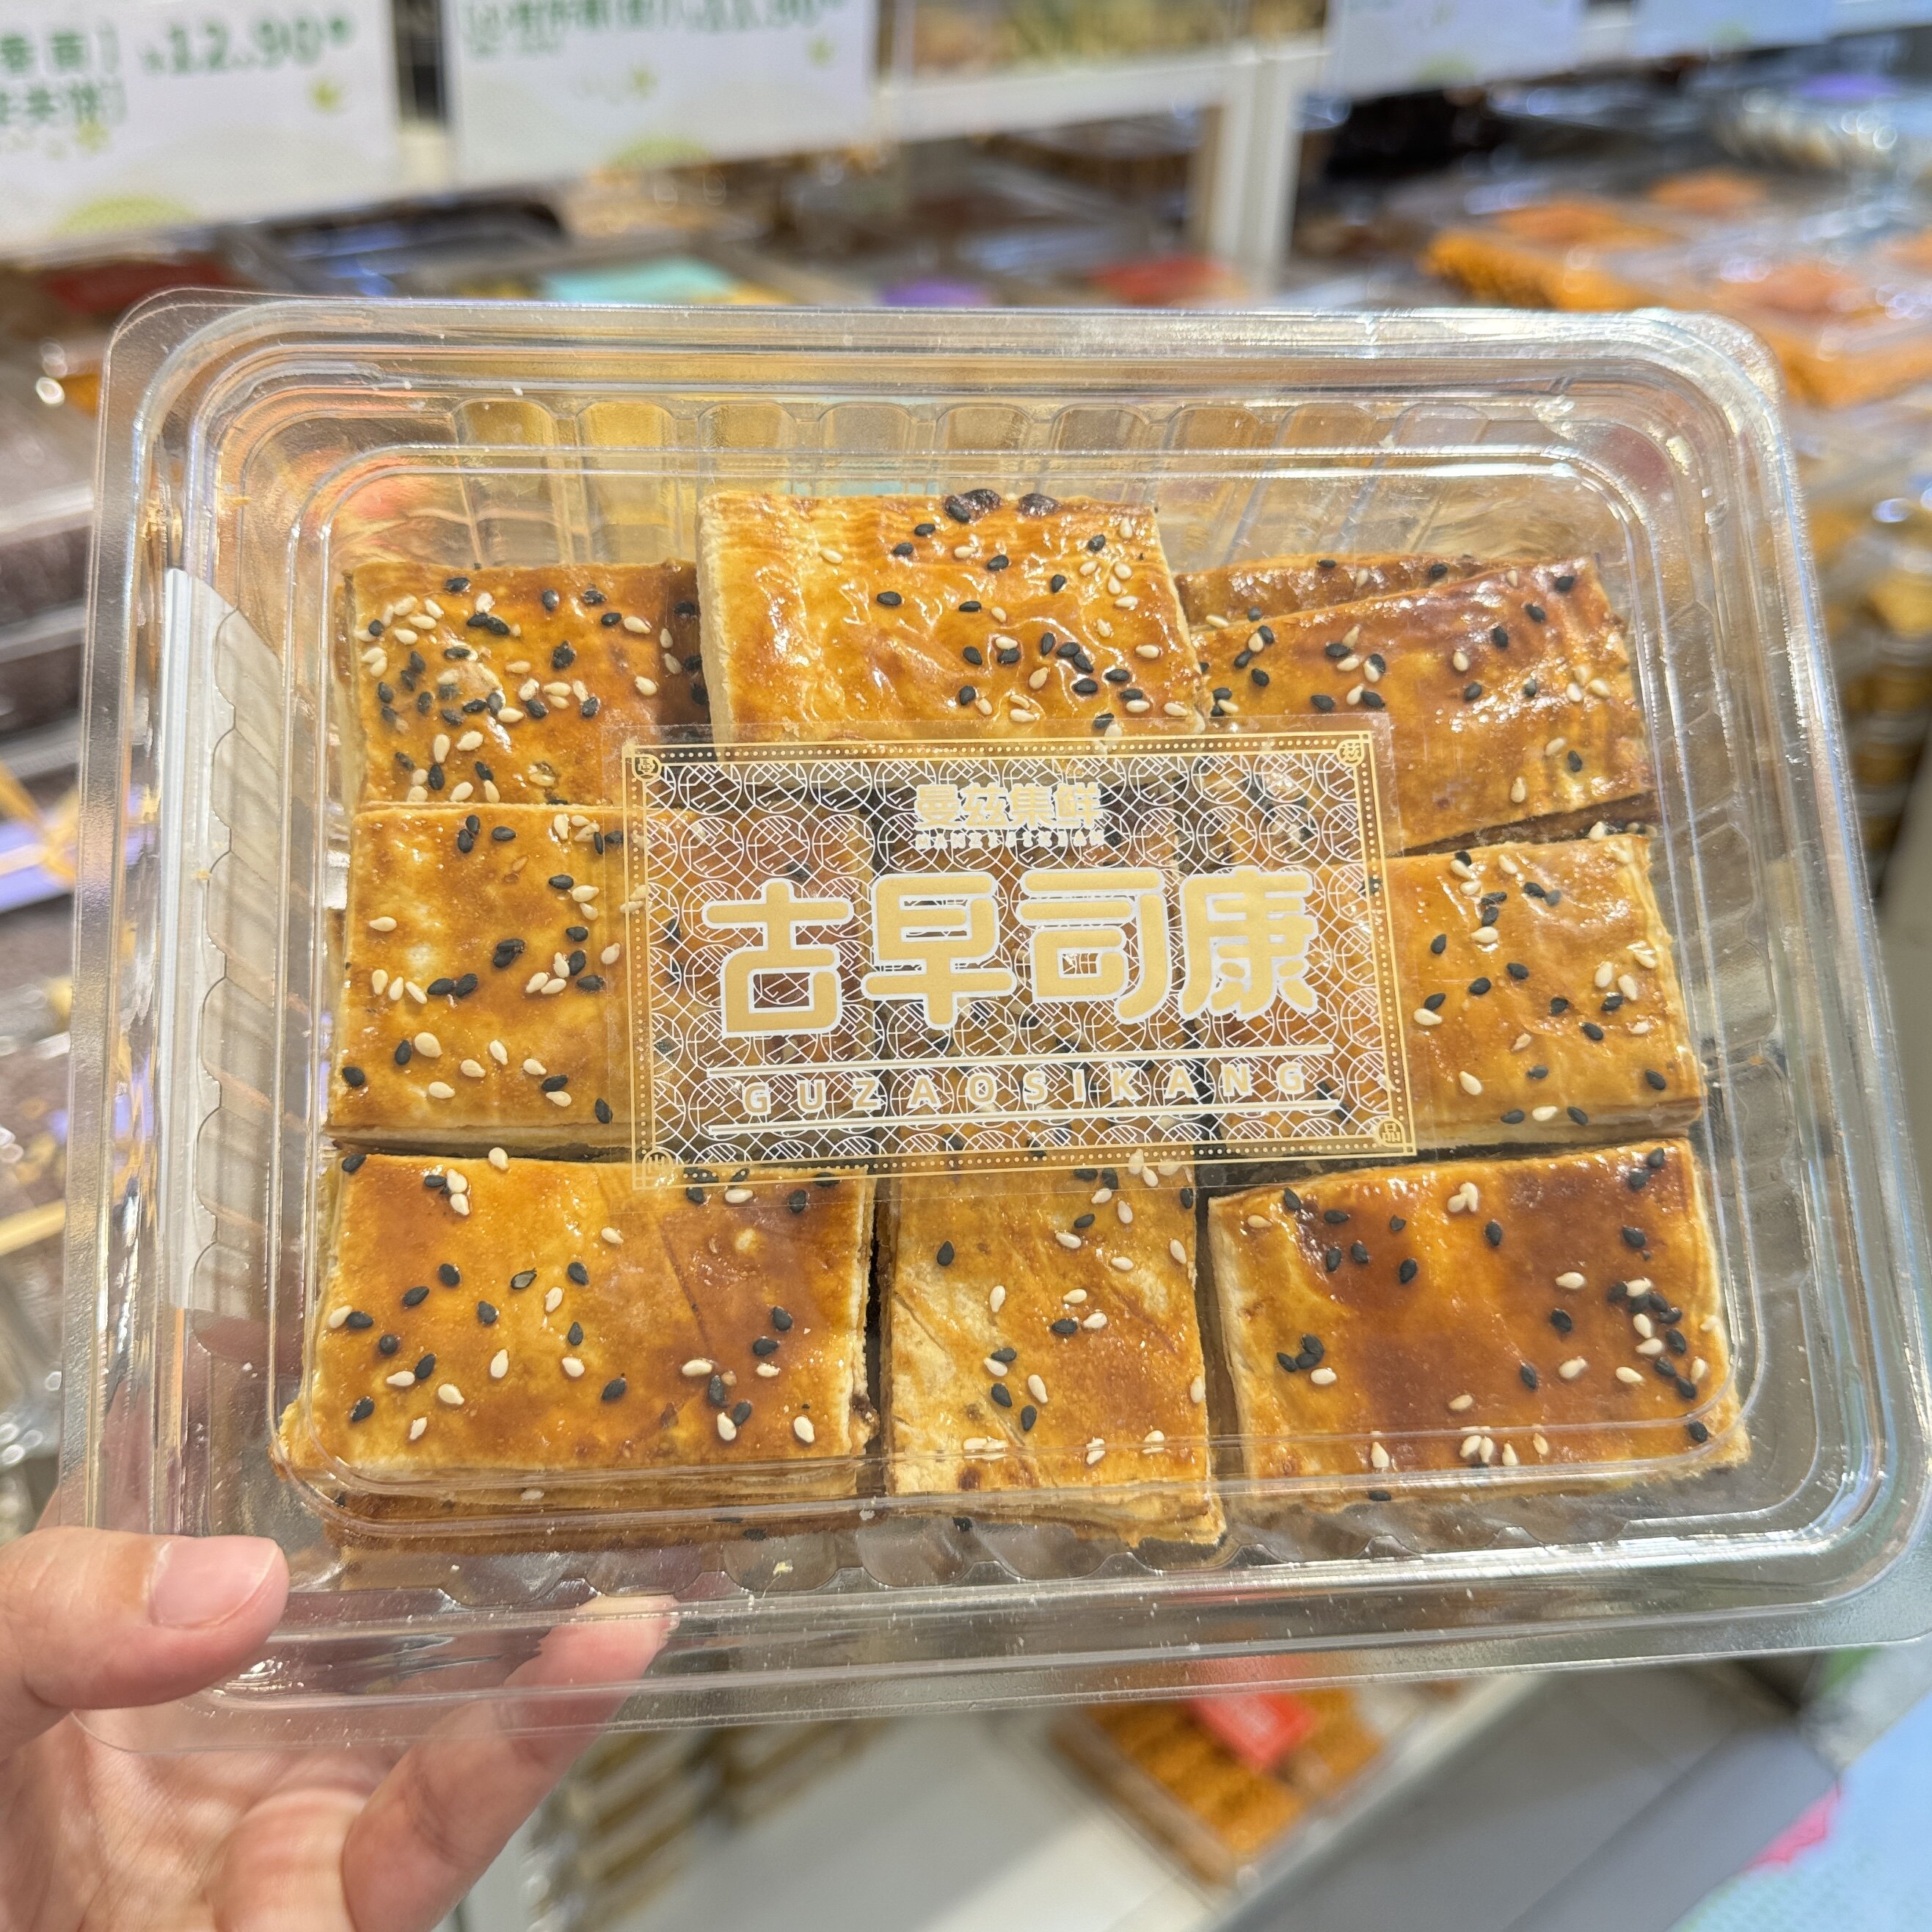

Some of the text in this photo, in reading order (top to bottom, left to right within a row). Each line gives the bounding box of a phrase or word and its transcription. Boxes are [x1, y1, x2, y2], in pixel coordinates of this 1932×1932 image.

[702, 866, 1320, 1038] 古早司康
[743, 1062, 1306, 1117] GUZAOSIKANG
